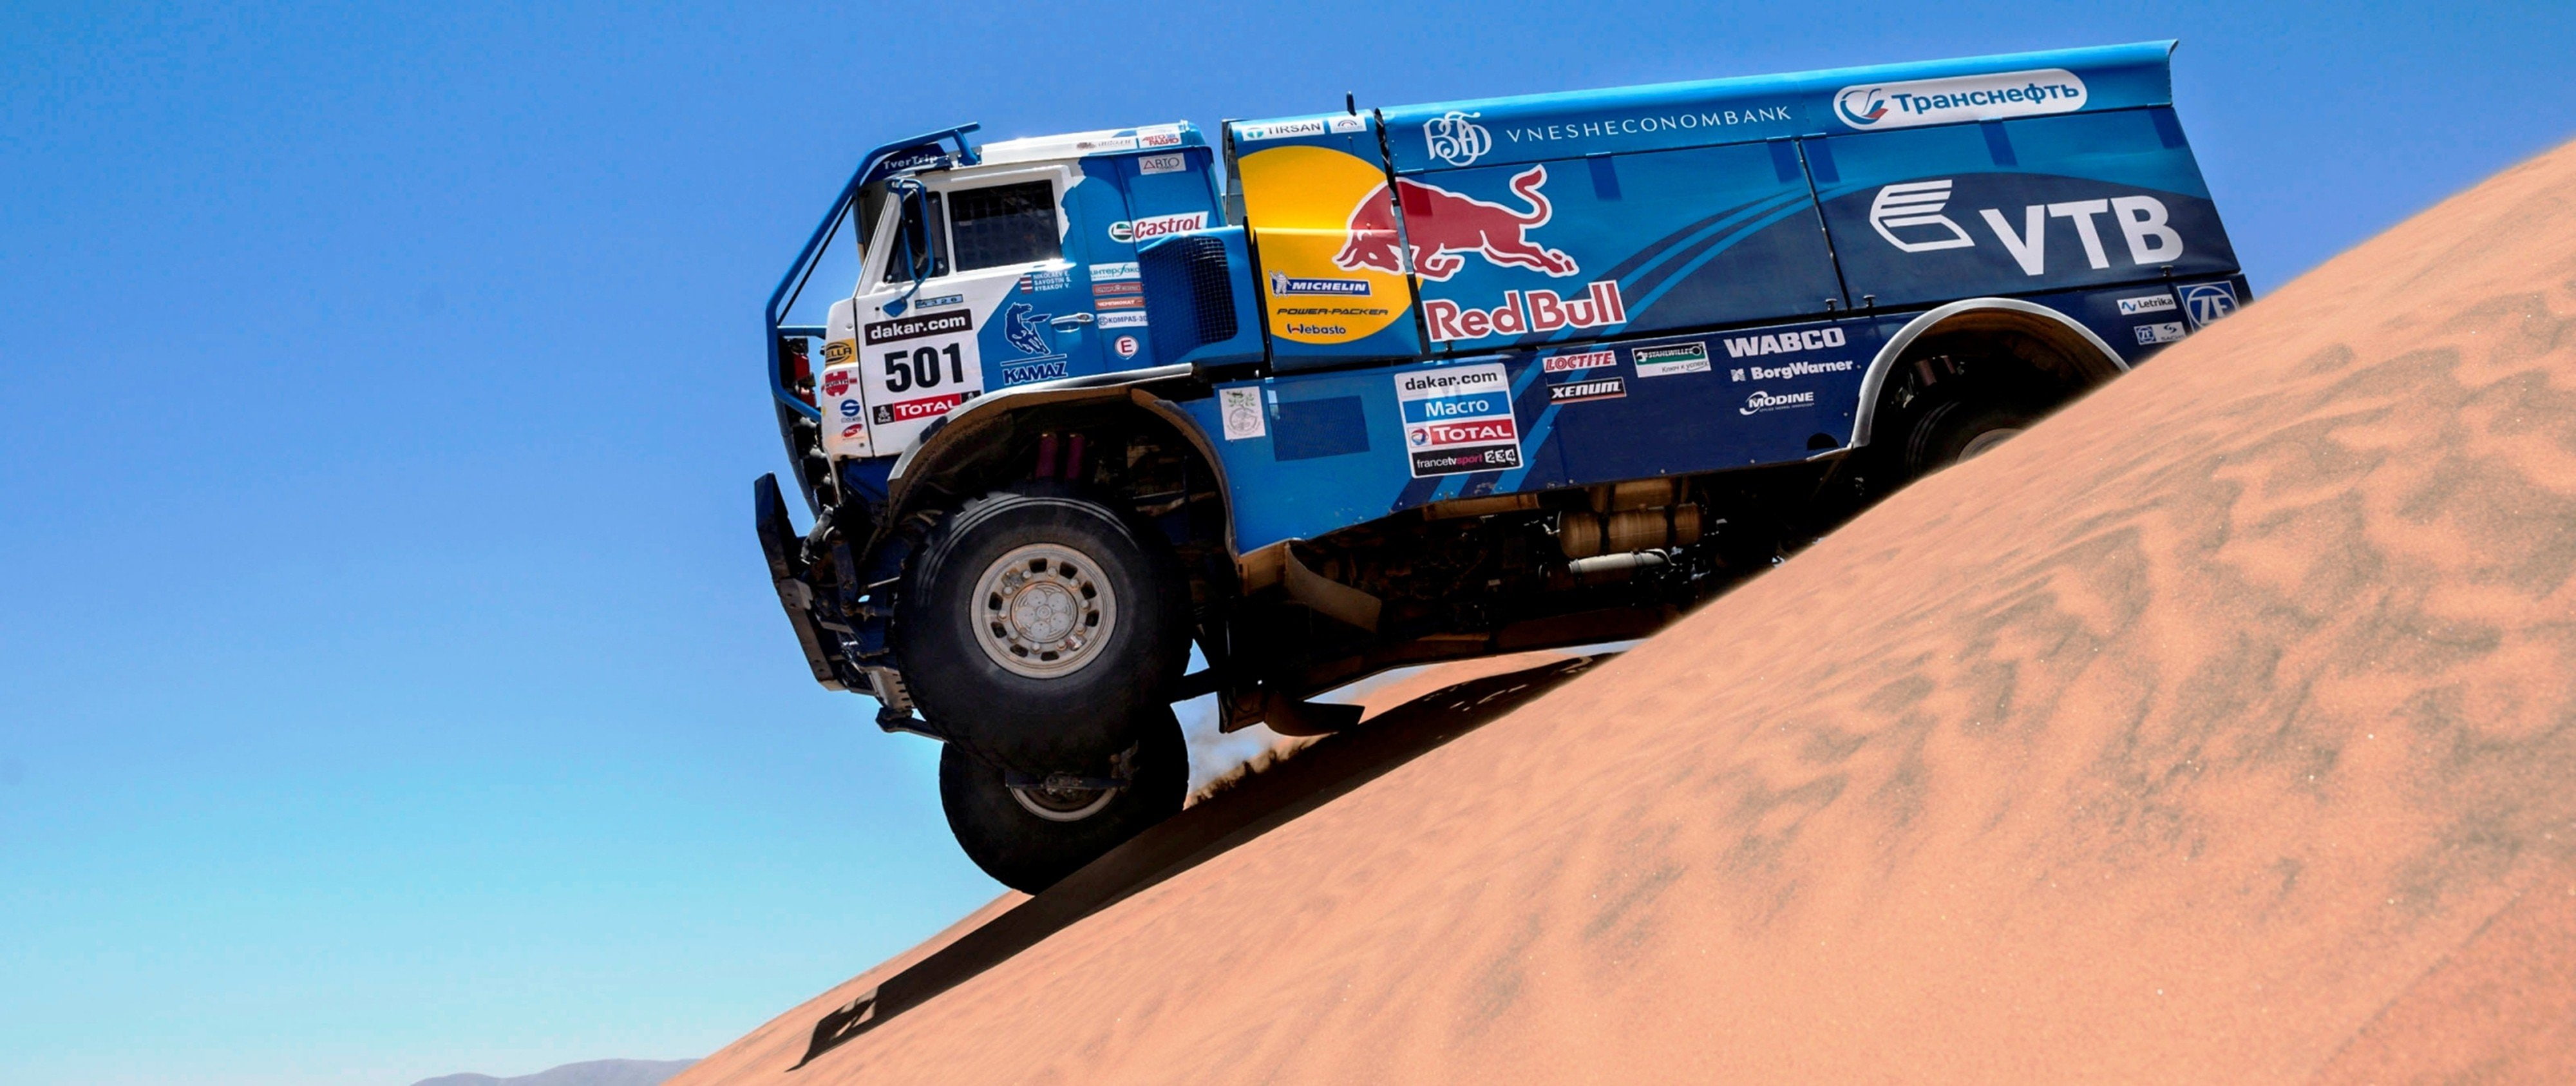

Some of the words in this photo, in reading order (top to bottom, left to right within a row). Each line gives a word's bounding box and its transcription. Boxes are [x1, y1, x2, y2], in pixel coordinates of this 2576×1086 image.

[1891, 83, 2079, 114] Транснефть
[1506, 106, 1792, 143] VNESHECONOMBANK
[1135, 215, 1202, 239] Castrol
[1979, 195, 2184, 276] VTB
[1291, 281, 1366, 292] MICHELIN
[1423, 290, 1527, 342] Red
[1526, 281, 1626, 332] Bull
[2137, 297, 2174, 309] Letrika
[870, 315, 966, 340] dakar.com
[1287, 323, 1347, 334] Webasto
[1120, 339, 1133, 354] E
[1723, 327, 1846, 358] WABCO
[884, 343, 964, 393] 501
[1546, 352, 1612, 371] LOCTITE
[1750, 360, 1853, 379] BorgWarner
[1003, 361, 1068, 385] KAMAZ
[1405, 372, 1498, 391] dakar.com
[896, 399, 955, 417] TOTAL
[1425, 399, 1490, 418] Macro
[1748, 392, 1814, 408] MODINE
[1432, 424, 1512, 442] TOTAL
[1417, 454, 1483, 469] francetvsport
